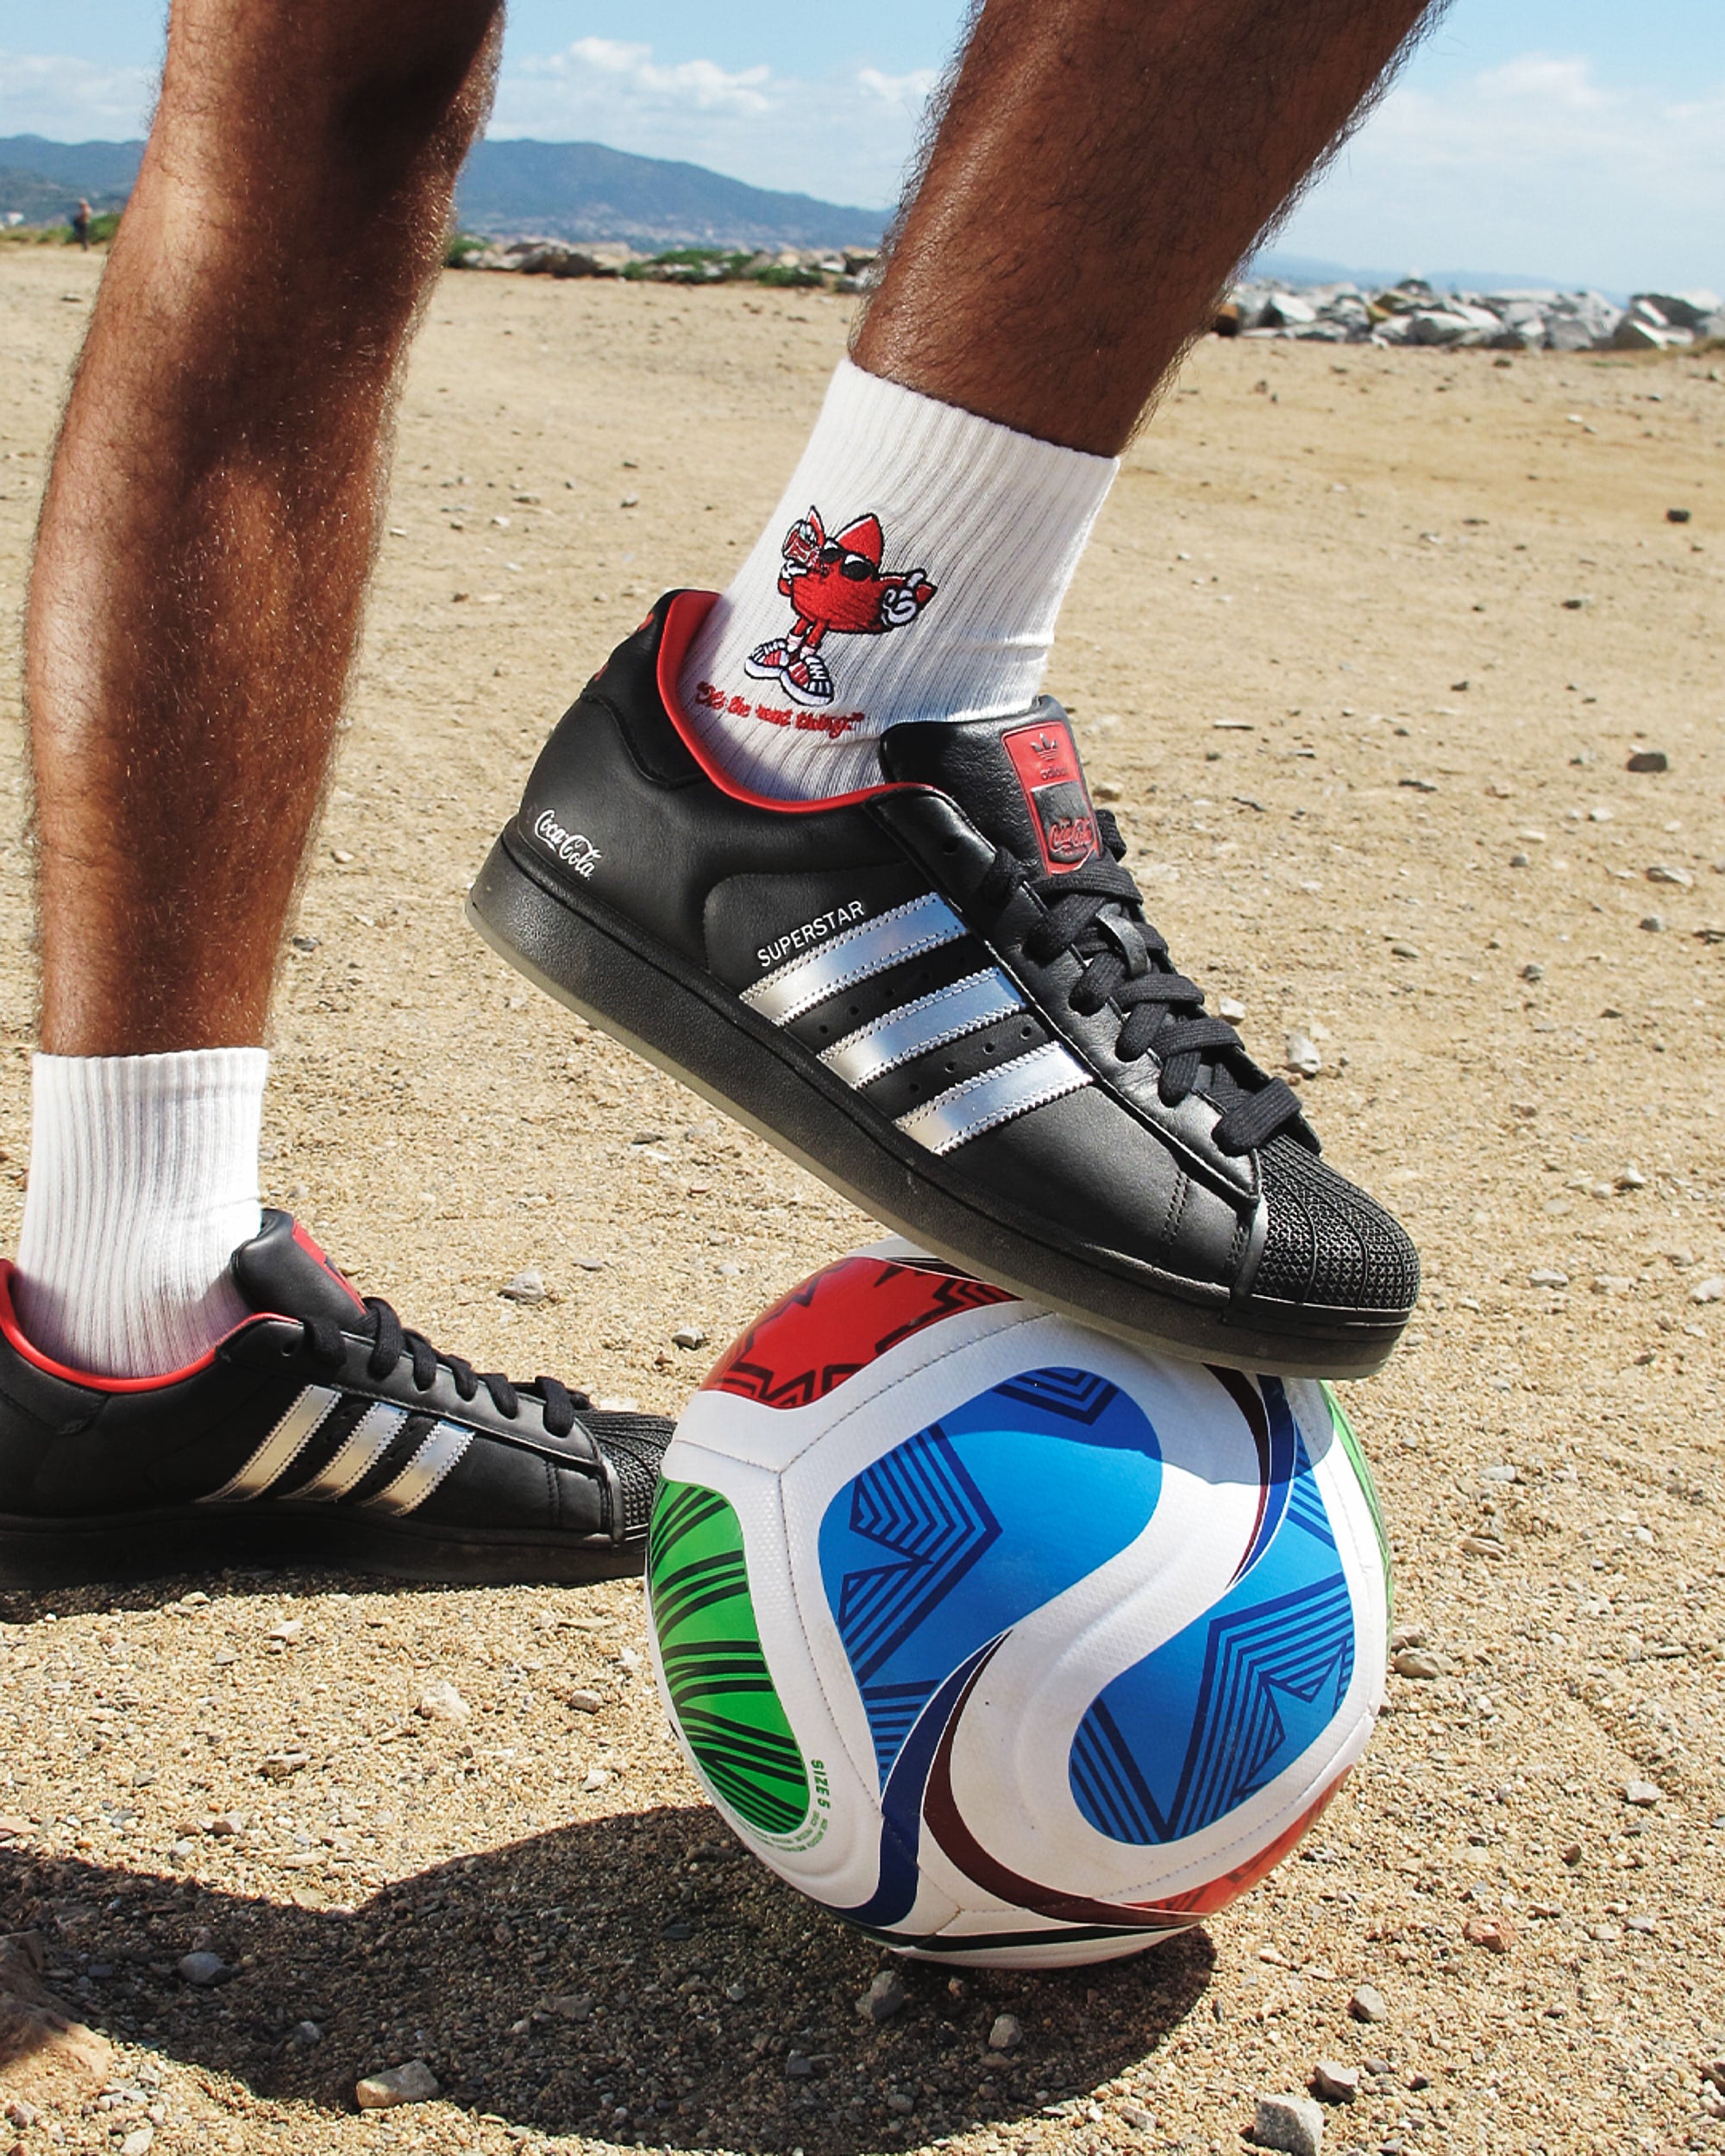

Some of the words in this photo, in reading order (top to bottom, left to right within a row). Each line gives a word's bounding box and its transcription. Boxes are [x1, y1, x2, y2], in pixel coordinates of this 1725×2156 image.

[756, 899, 865, 968] SUPERSTAR
[811, 1758, 831, 1796] SIZE
[817, 1797, 831, 1809] 5
